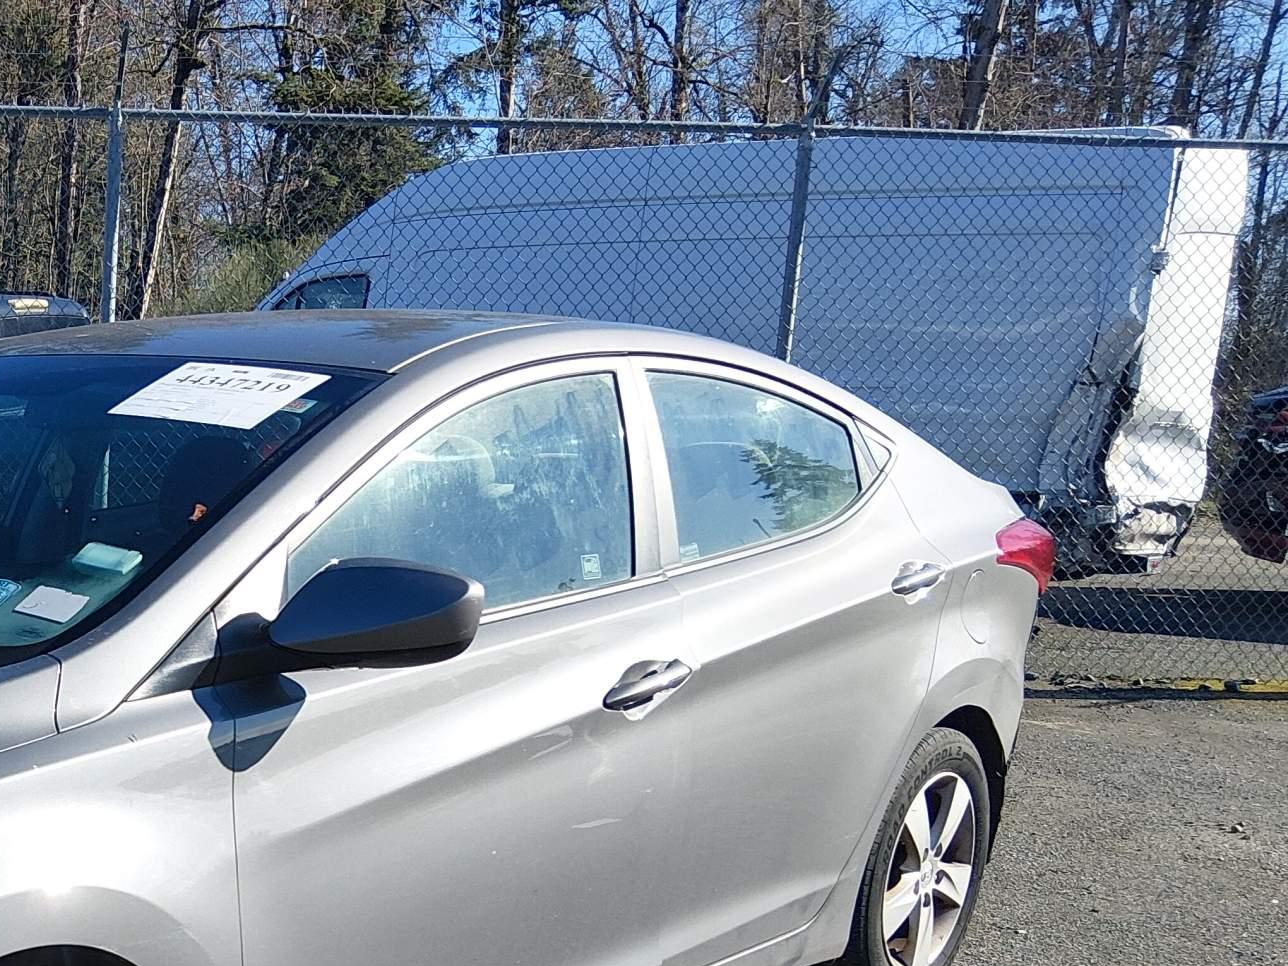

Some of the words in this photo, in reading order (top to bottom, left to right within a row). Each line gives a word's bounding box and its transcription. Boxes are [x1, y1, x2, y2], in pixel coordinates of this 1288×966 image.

[176, 374, 291, 393] 44347219
[907, 746, 953, 801] CONTROL
[955, 745, 962, 757] 2
